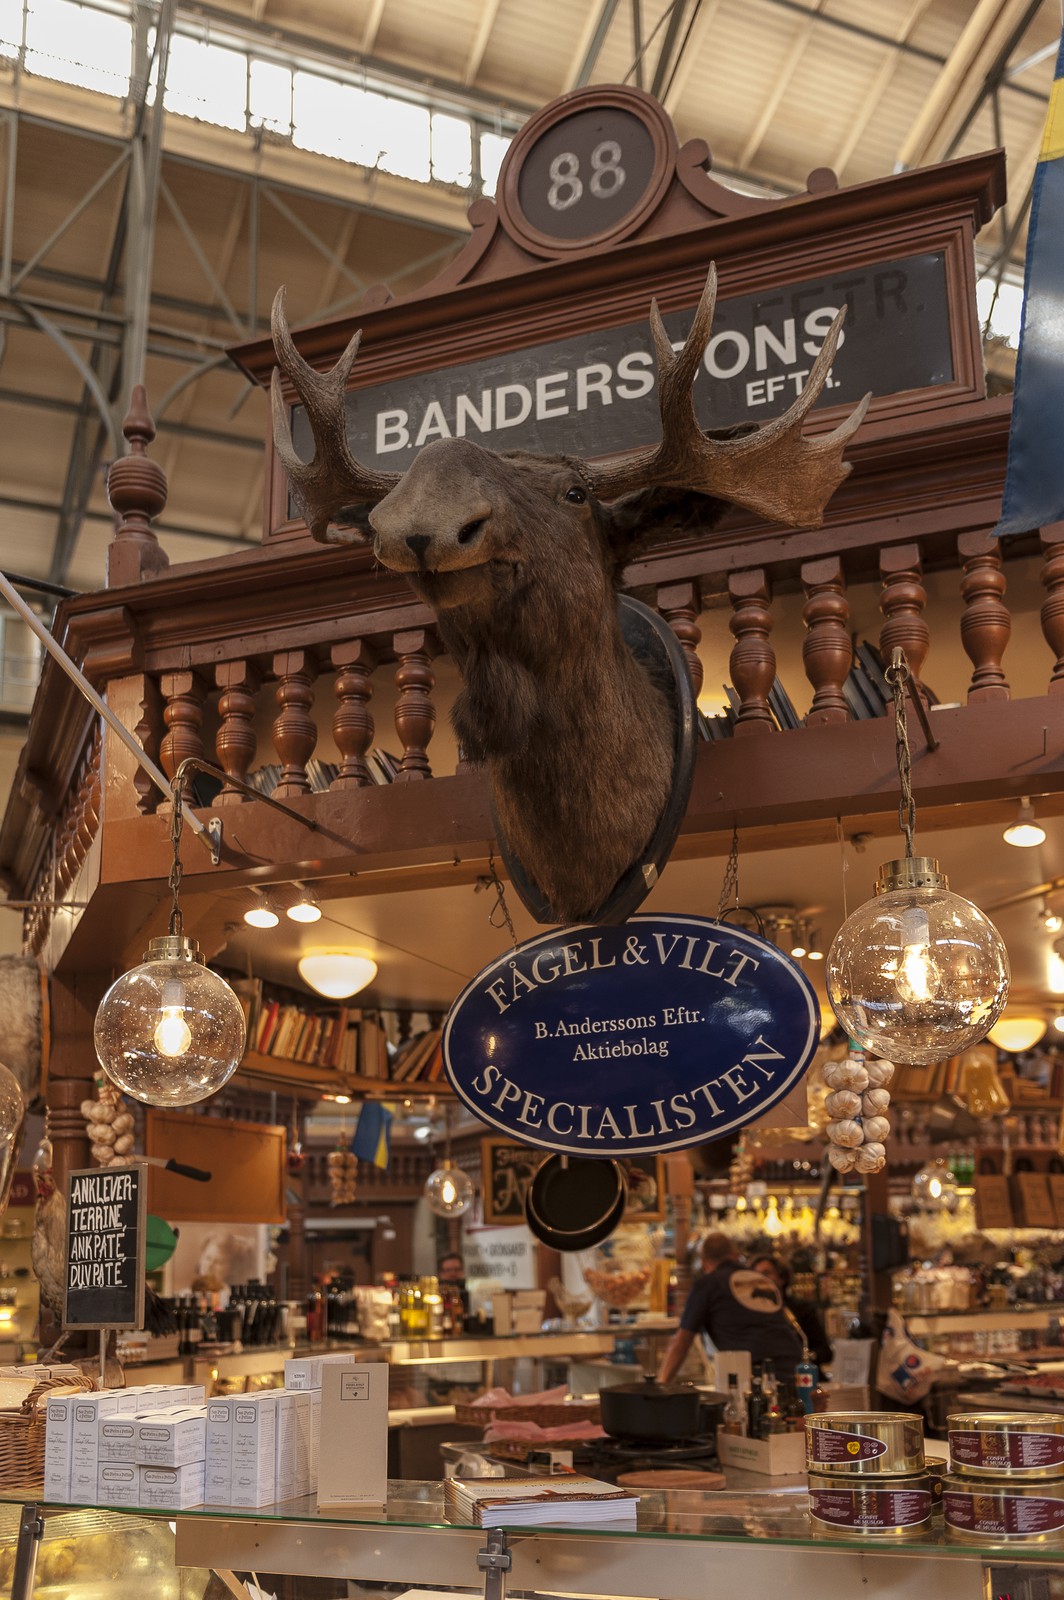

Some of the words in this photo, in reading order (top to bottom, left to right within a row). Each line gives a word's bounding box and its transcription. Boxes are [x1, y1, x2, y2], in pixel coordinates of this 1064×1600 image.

[547, 140, 626, 211] 88
[484, 937, 616, 1014] FÅGEL
[534, 1014, 657, 1039] B.Anderssons
[663, 1006, 706, 1026] Eftr.
[572, 1037, 669, 1061] Aktiebolag
[471, 1034, 786, 1140] SPECIALISTEN
